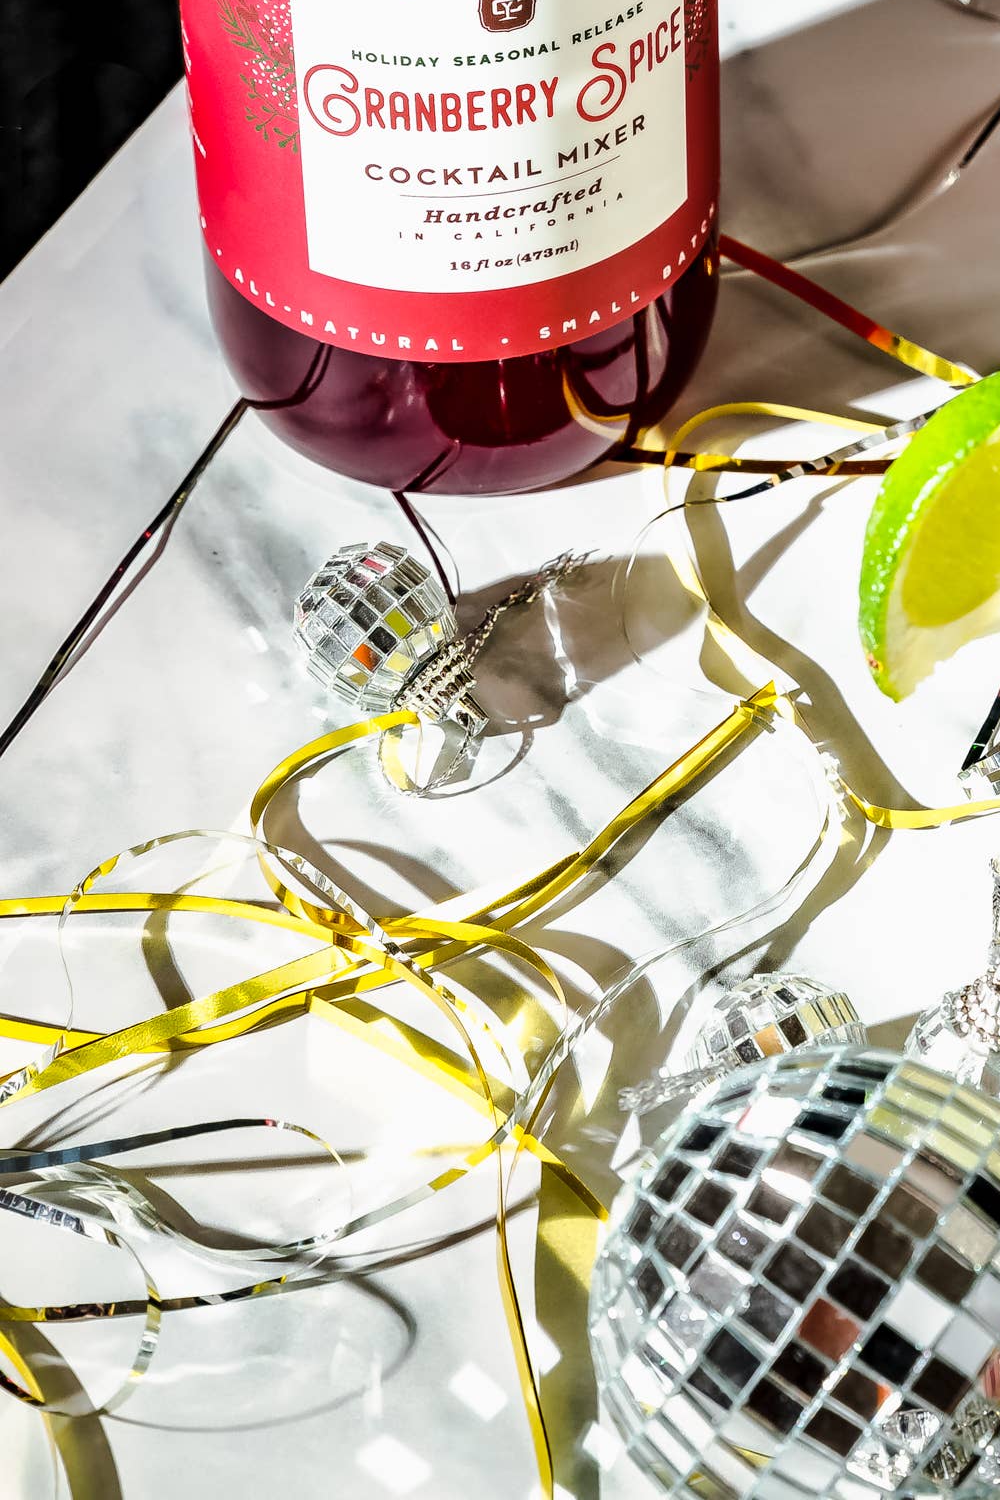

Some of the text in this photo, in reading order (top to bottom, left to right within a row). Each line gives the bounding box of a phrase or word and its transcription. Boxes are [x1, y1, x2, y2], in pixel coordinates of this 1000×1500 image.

[351, 1, 644, 68] HOLIDAY SEASONAL RELEASE
[303, 7, 683, 137] CRANBERRY SPICE
[364, 113, 647, 187] COCKTAIL MIXER
[398, 192, 624, 241] IN CALIFORNIA
[424, 177, 603, 224] Handcrafted
[450, 239, 579, 272] 16 fl oz (473ml)
[234, 268, 464, 351] ALL-NATURAL
[539, 291, 640, 339] SMALL
